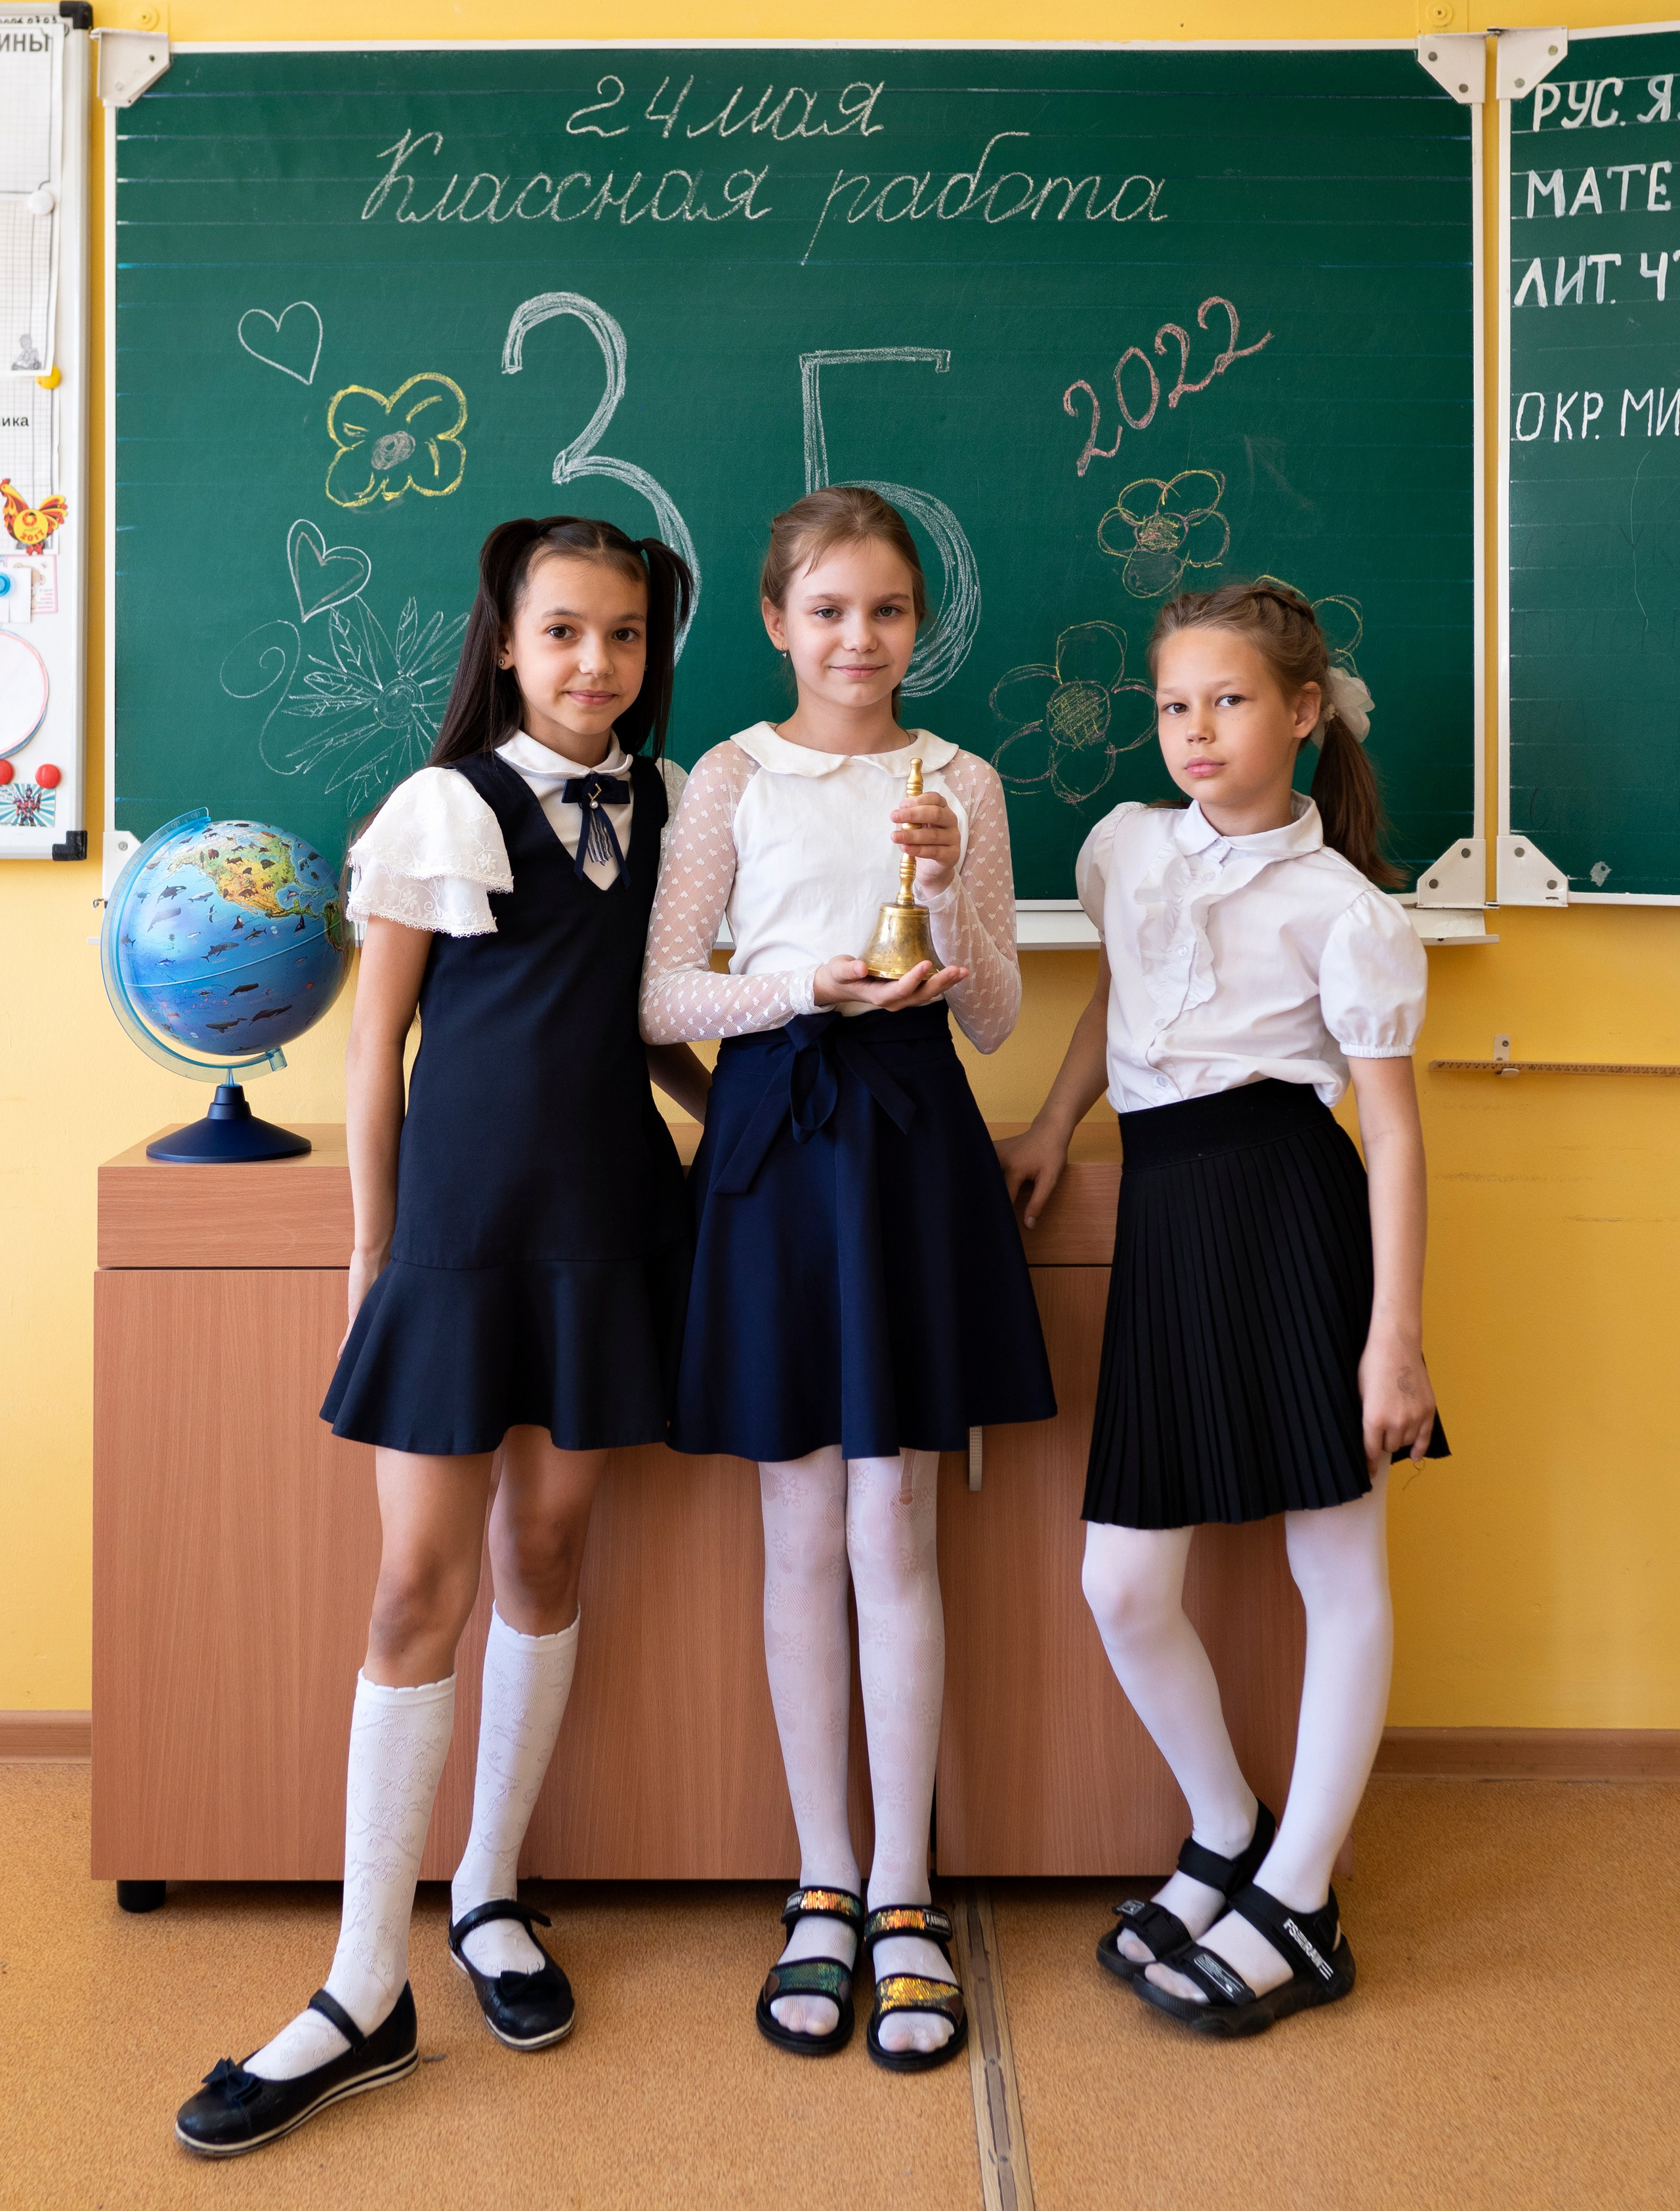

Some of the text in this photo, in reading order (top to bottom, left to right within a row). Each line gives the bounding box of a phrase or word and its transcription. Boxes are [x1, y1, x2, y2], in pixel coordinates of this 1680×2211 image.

[566, 74, 885, 140] 24 мая
[1533, 73, 1680, 132] РУС. Я
[361, 128, 1168, 266] Классная работа
[1527, 161, 1673, 219] МАТЕ
[1514, 249, 1680, 308] ЛИТ. Ч
[1063, 296, 1274, 478] 2022
[0, 415, 30, 427] ика
[1515, 391, 1604, 444] ОКР.
